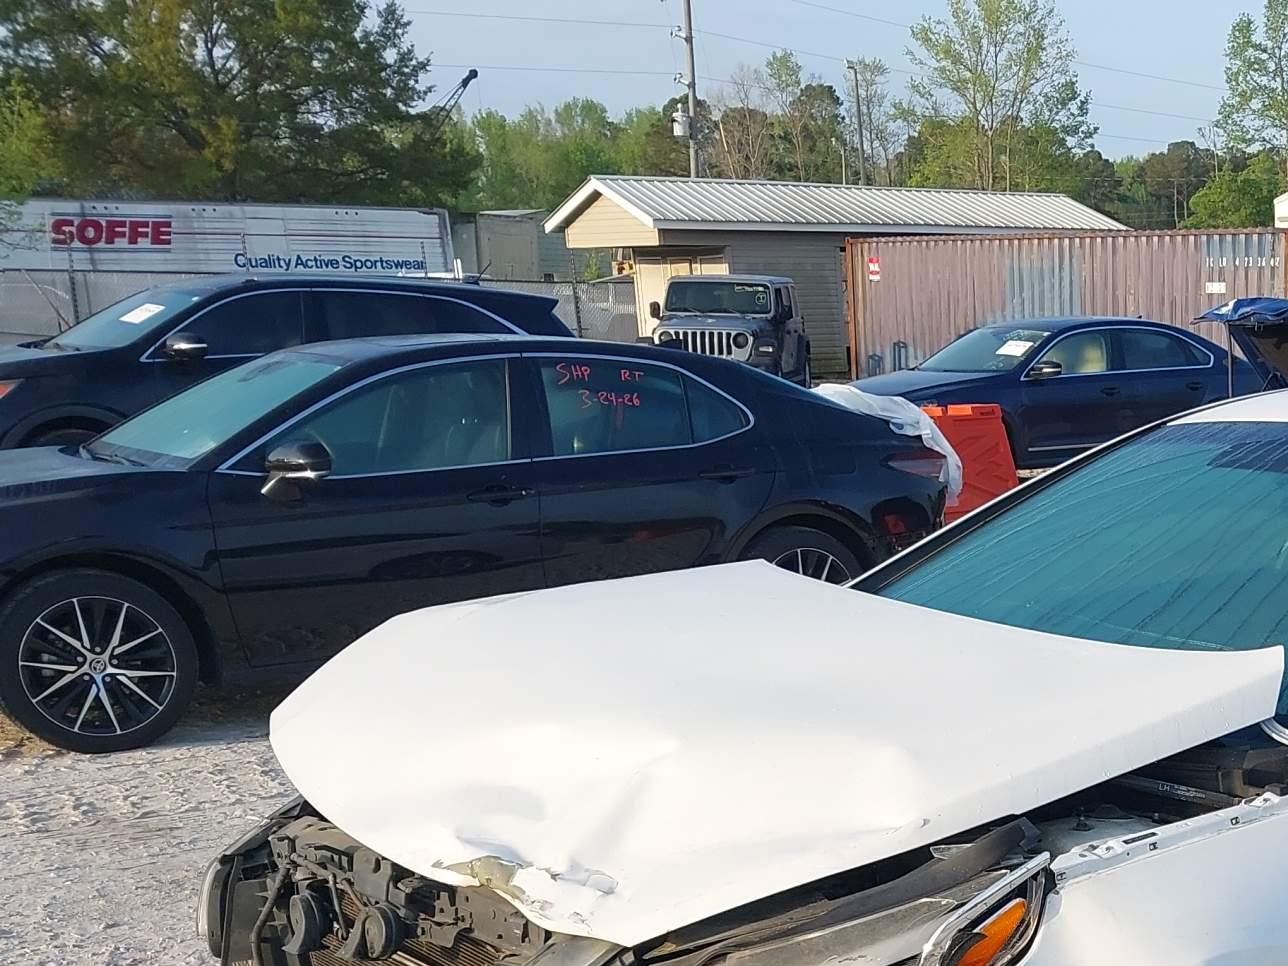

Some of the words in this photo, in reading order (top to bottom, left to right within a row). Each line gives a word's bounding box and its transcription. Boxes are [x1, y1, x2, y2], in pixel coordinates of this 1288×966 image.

[51, 218, 172, 246] SOFFE
[234, 252, 292, 271] Quality
[295, 254, 340, 270] Active
[556, 363, 591, 384] SHP
[620, 369, 644, 380] RT
[578, 390, 641, 408] 3-24-26
